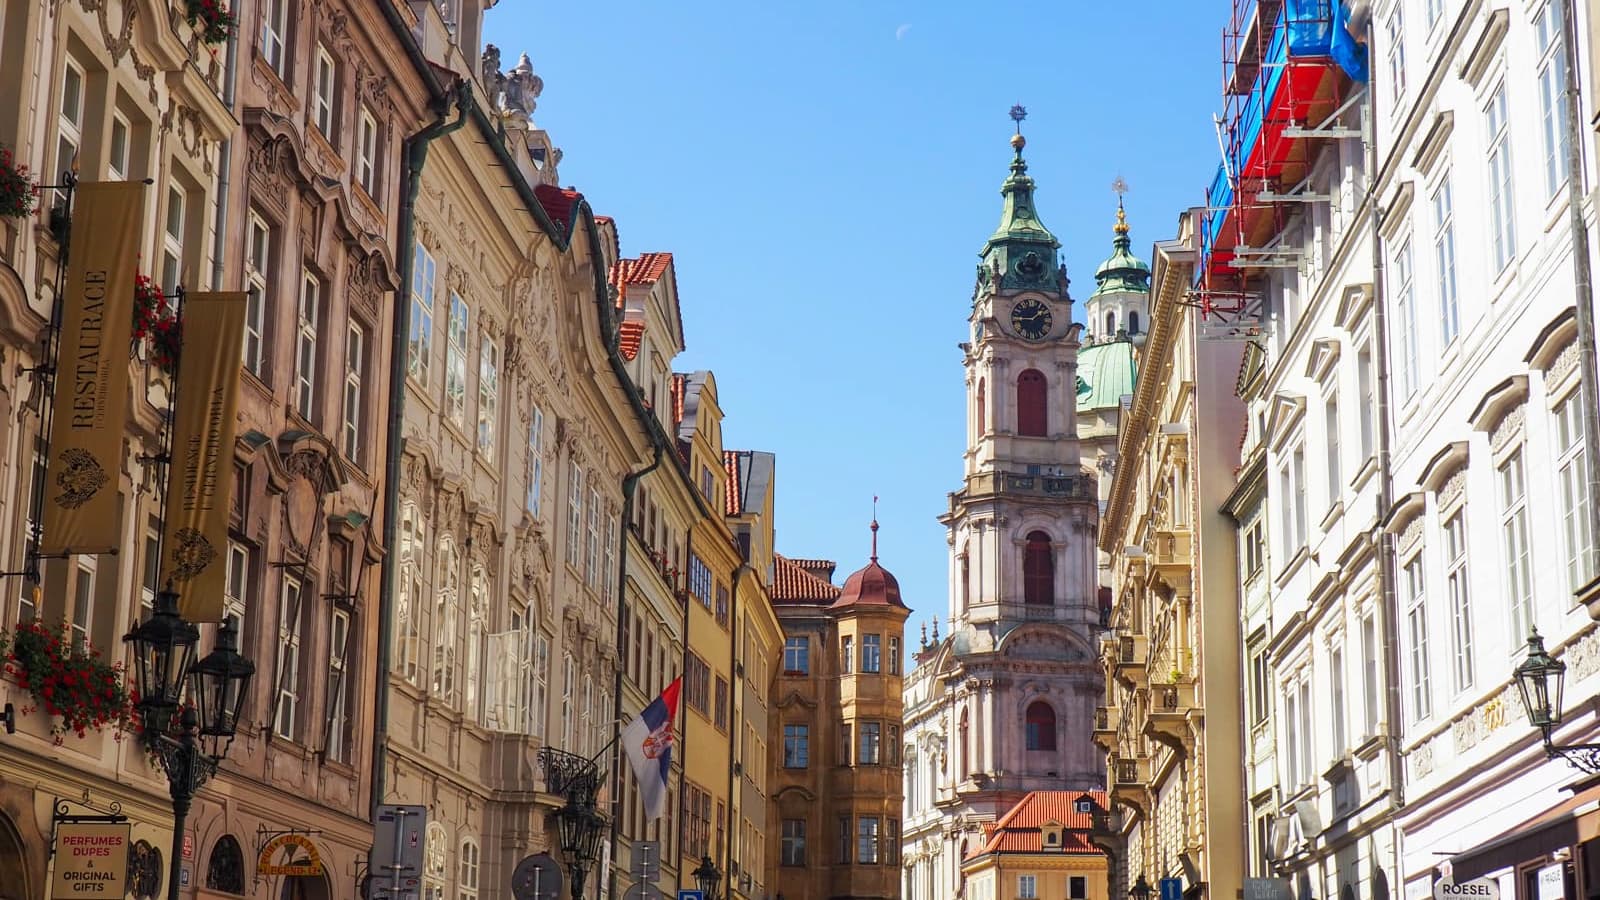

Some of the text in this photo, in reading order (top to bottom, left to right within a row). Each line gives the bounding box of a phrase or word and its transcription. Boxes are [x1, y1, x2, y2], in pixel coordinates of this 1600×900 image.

[71, 270, 107, 431] RESTAURACE
[63, 836, 123, 846] PERFUMES
[72, 847, 110, 857] DUPES
[87, 860, 94, 868] &
[63, 871, 116, 881] ORIGINAL
[73, 882, 105, 892] GIFTS
[1443, 884, 1491, 895] ROESEL
